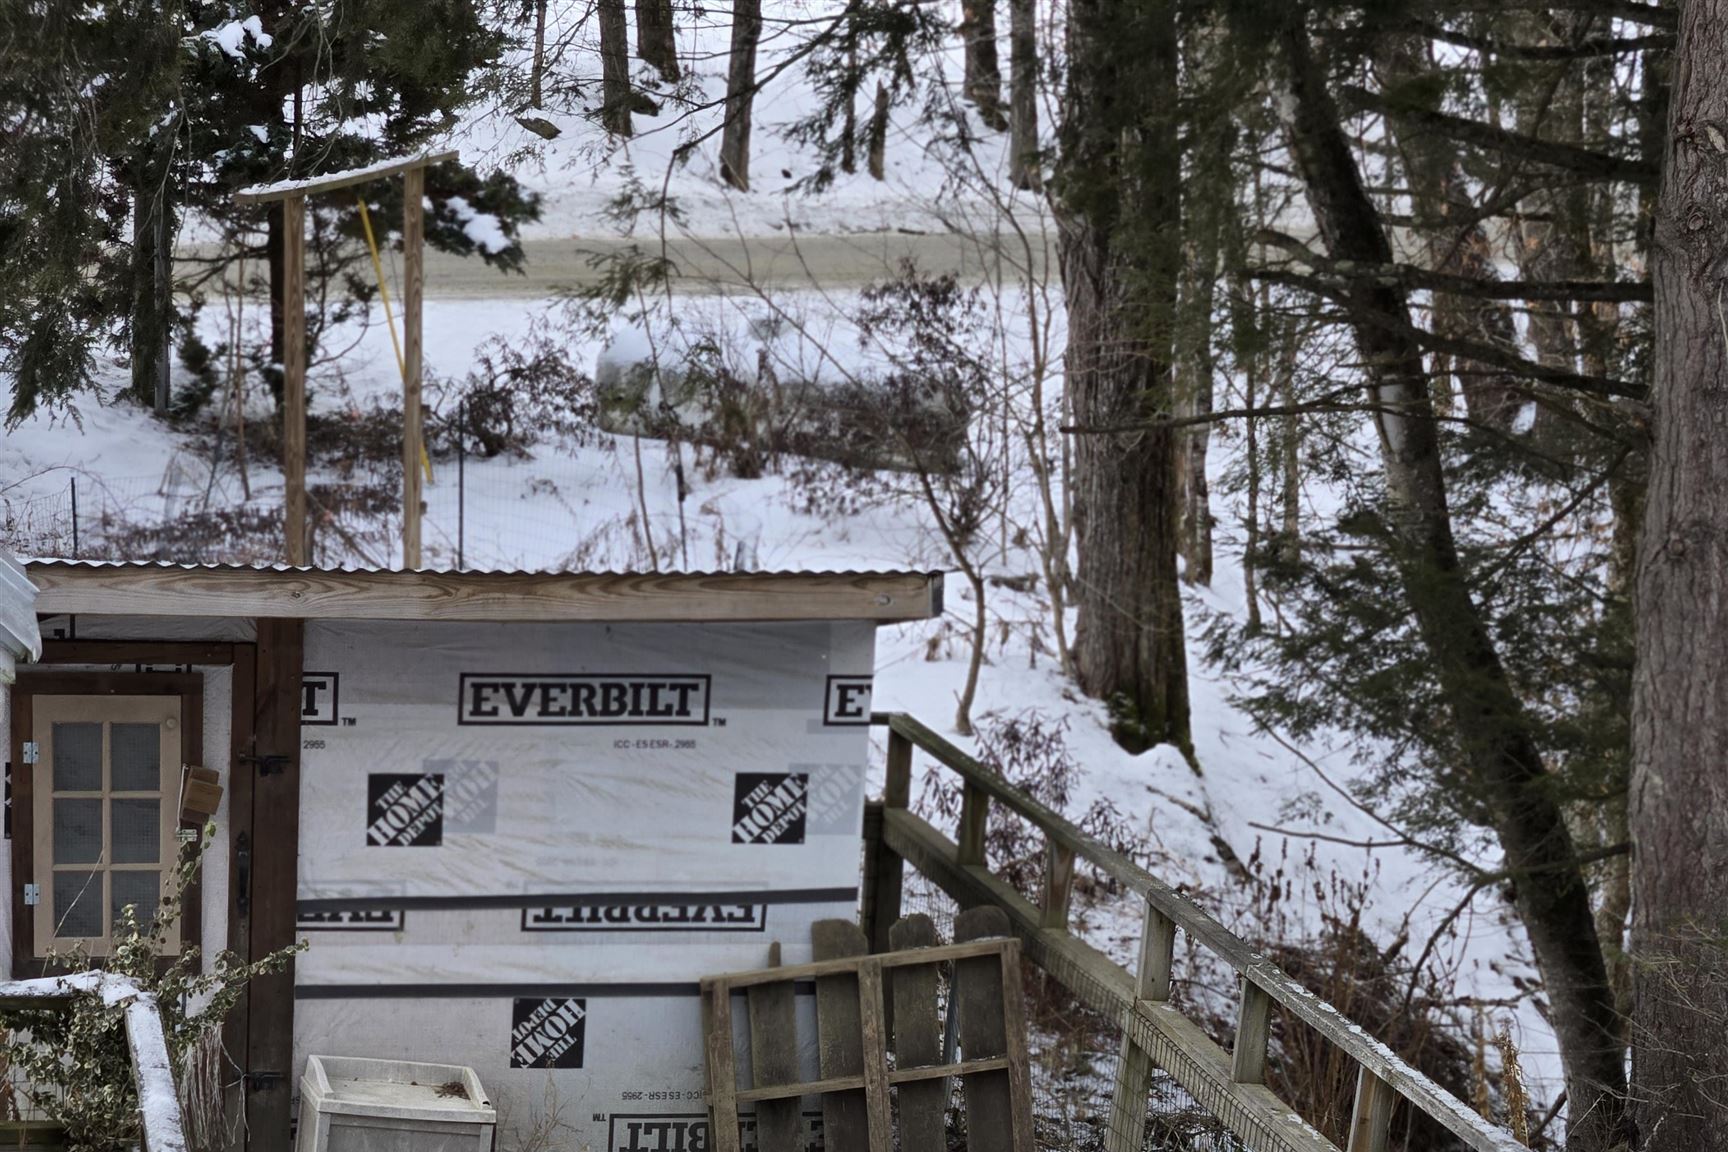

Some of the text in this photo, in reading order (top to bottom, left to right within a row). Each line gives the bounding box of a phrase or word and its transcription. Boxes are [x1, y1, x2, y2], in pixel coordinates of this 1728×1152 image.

[469, 682, 700, 717] EVERBILT
[835, 683, 873, 718] E
[367, 772, 445, 846] HOME
[375, 780, 408, 810] THE
[732, 772, 810, 844] HOME
[741, 779, 773, 809] THE
[397, 800, 445, 847] DEPOT
[761, 801, 807, 845] DEPOT
[511, 998, 586, 1068] HOME
[512, 998, 557, 1042] DEPOT
[546, 1033, 577, 1061] THE
